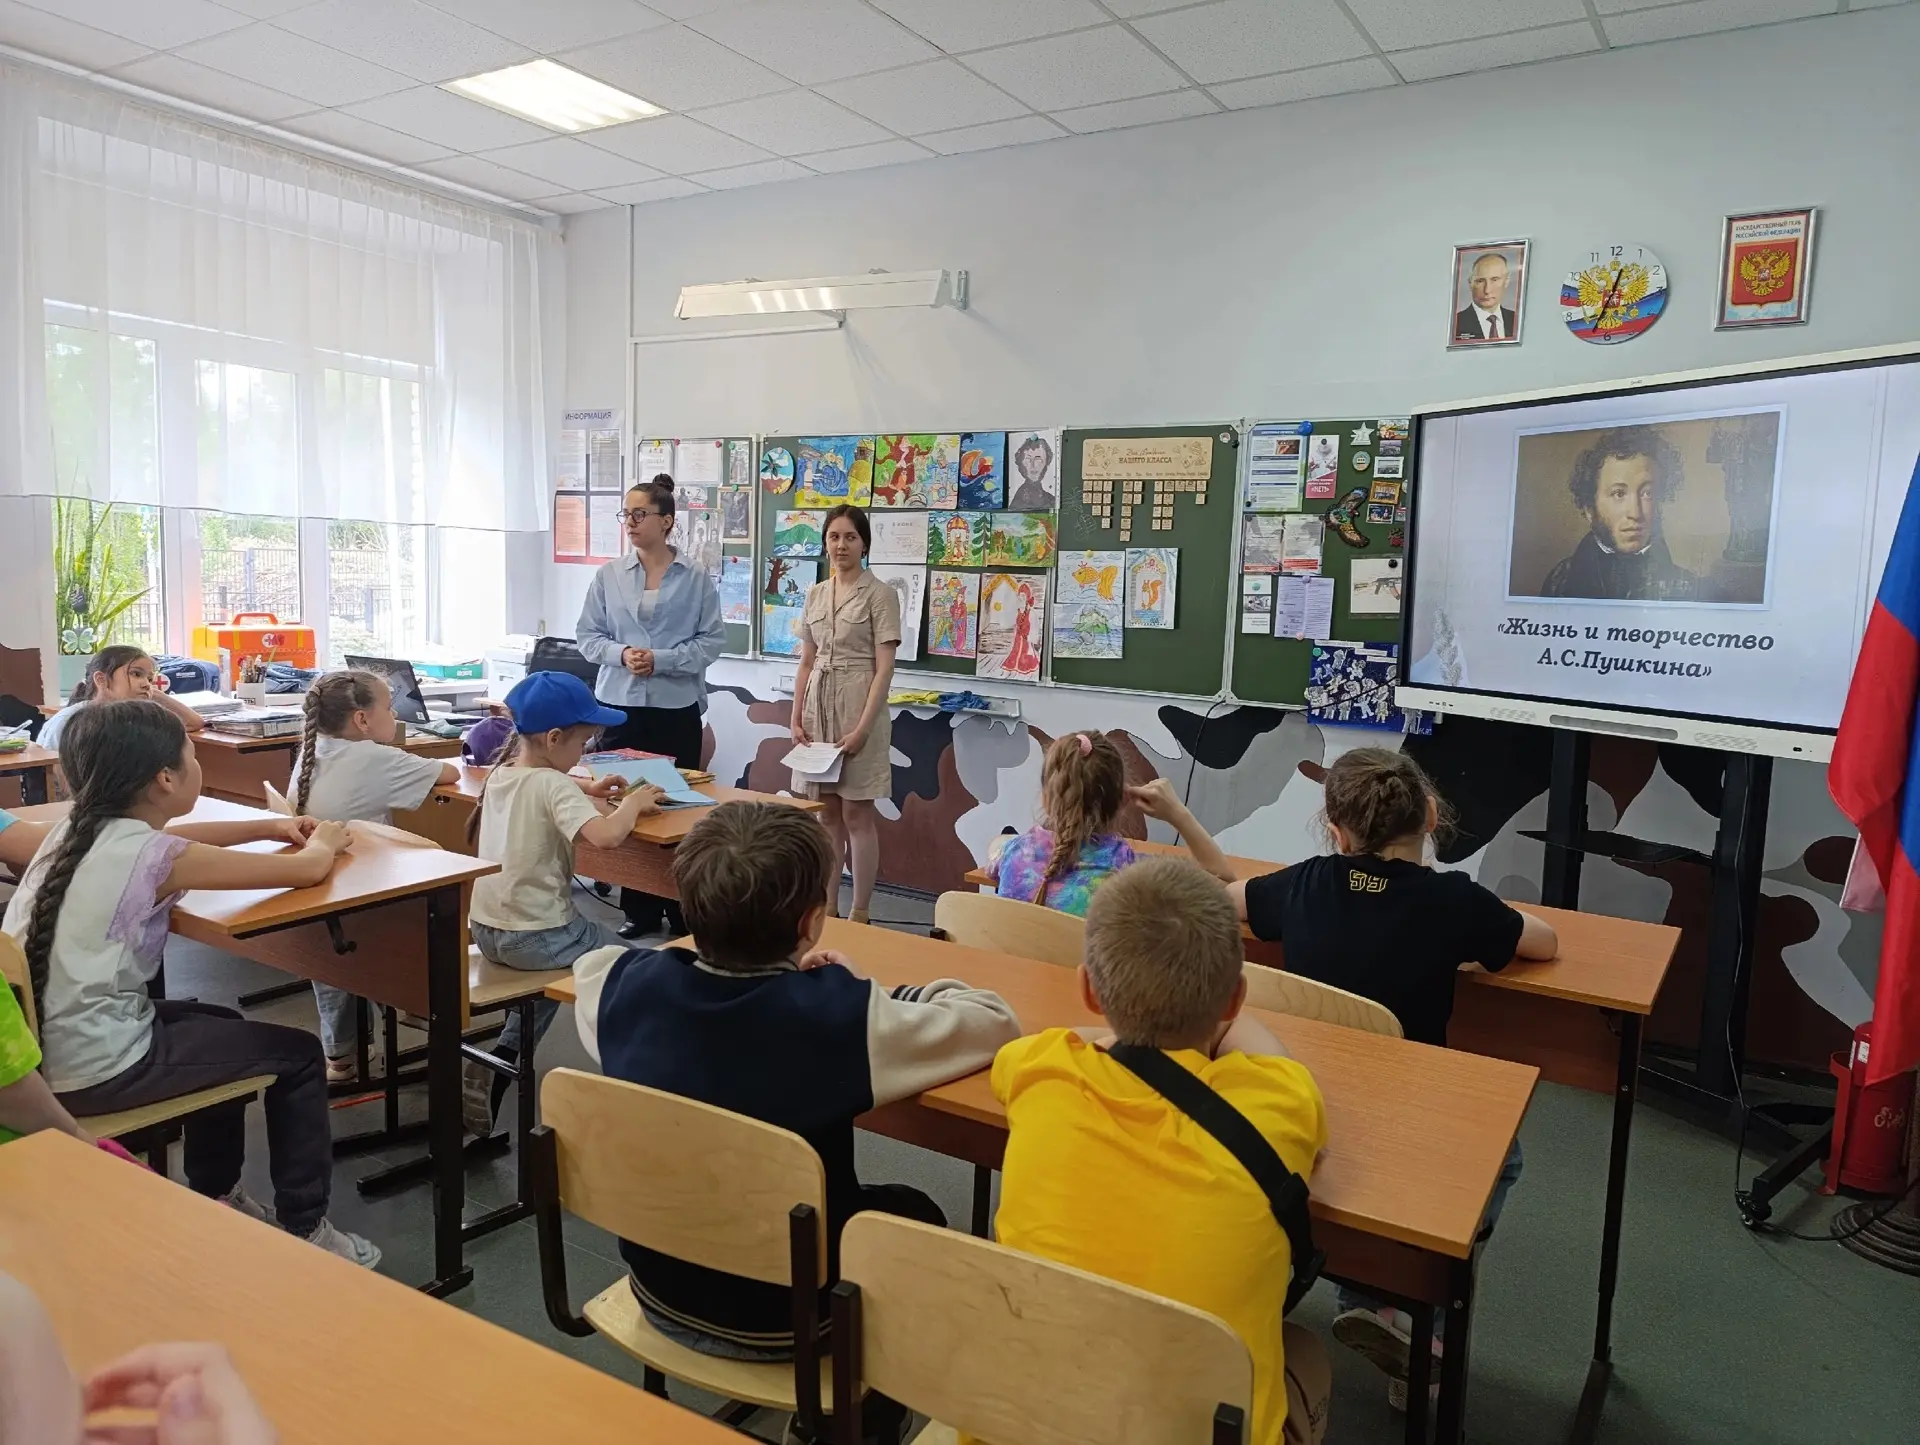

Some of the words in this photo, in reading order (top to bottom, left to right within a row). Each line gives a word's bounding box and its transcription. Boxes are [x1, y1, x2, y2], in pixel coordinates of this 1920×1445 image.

[1610, 246, 1623, 256] 12
[1590, 252, 1600, 262] 11
[1653, 265, 1660, 275] 2
[1570, 272, 1581, 281] 10
[1562, 292, 1571, 301] 9
[1565, 312, 1573, 321] 8
[1603, 332, 1611, 341] 6
[565, 411, 612, 420] ИНФОРМАЦИЯ
[1147, 456, 1172, 464] КЛАССА
[1498, 617, 1579, 638] «Жизнь
[1584, 626, 1599, 640] и
[1606, 626, 1775, 651] творчество
[1537, 647, 1712, 678] А.С.Пушкина»
